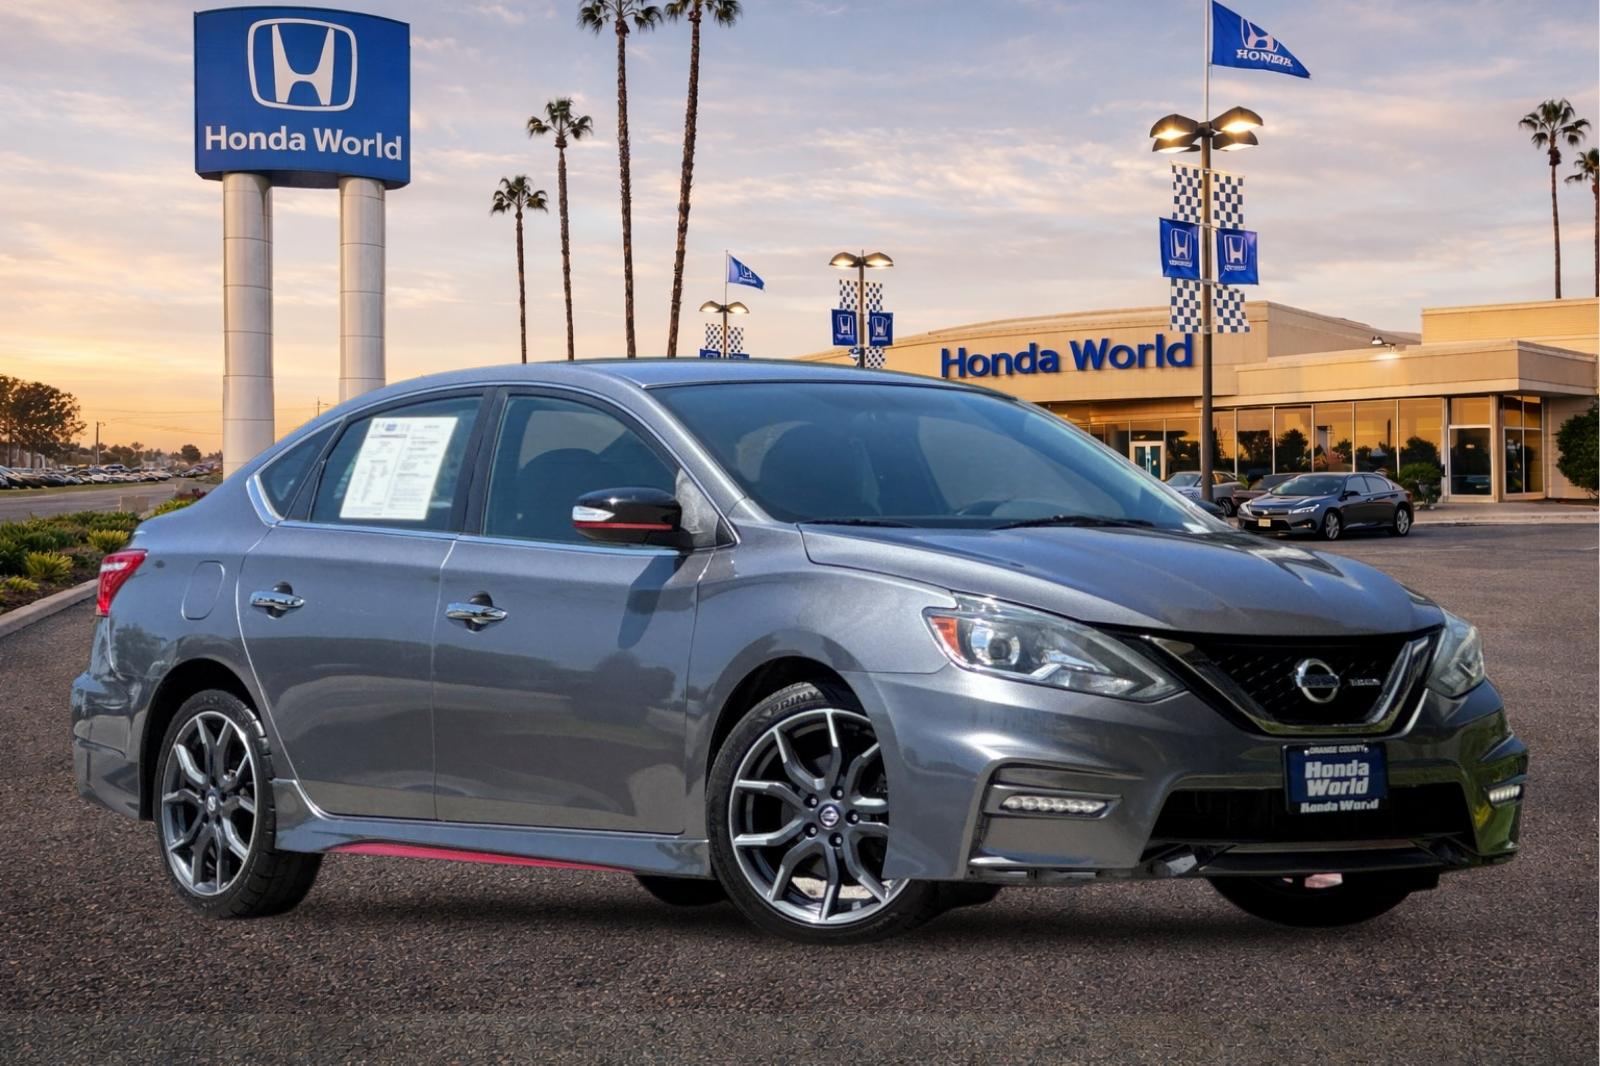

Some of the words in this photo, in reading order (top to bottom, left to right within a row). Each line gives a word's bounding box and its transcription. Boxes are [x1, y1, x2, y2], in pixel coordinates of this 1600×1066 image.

[205, 125, 306, 151] Honda
[313, 127, 402, 161] World
[941, 342, 1060, 378] Honda
[1069, 332, 1194, 371] World
[1309, 746, 1338, 754] ORANGE
[1339, 744, 1365, 753] COUNTY
[1305, 760, 1370, 778] Honda
[1307, 777, 1369, 797] World
